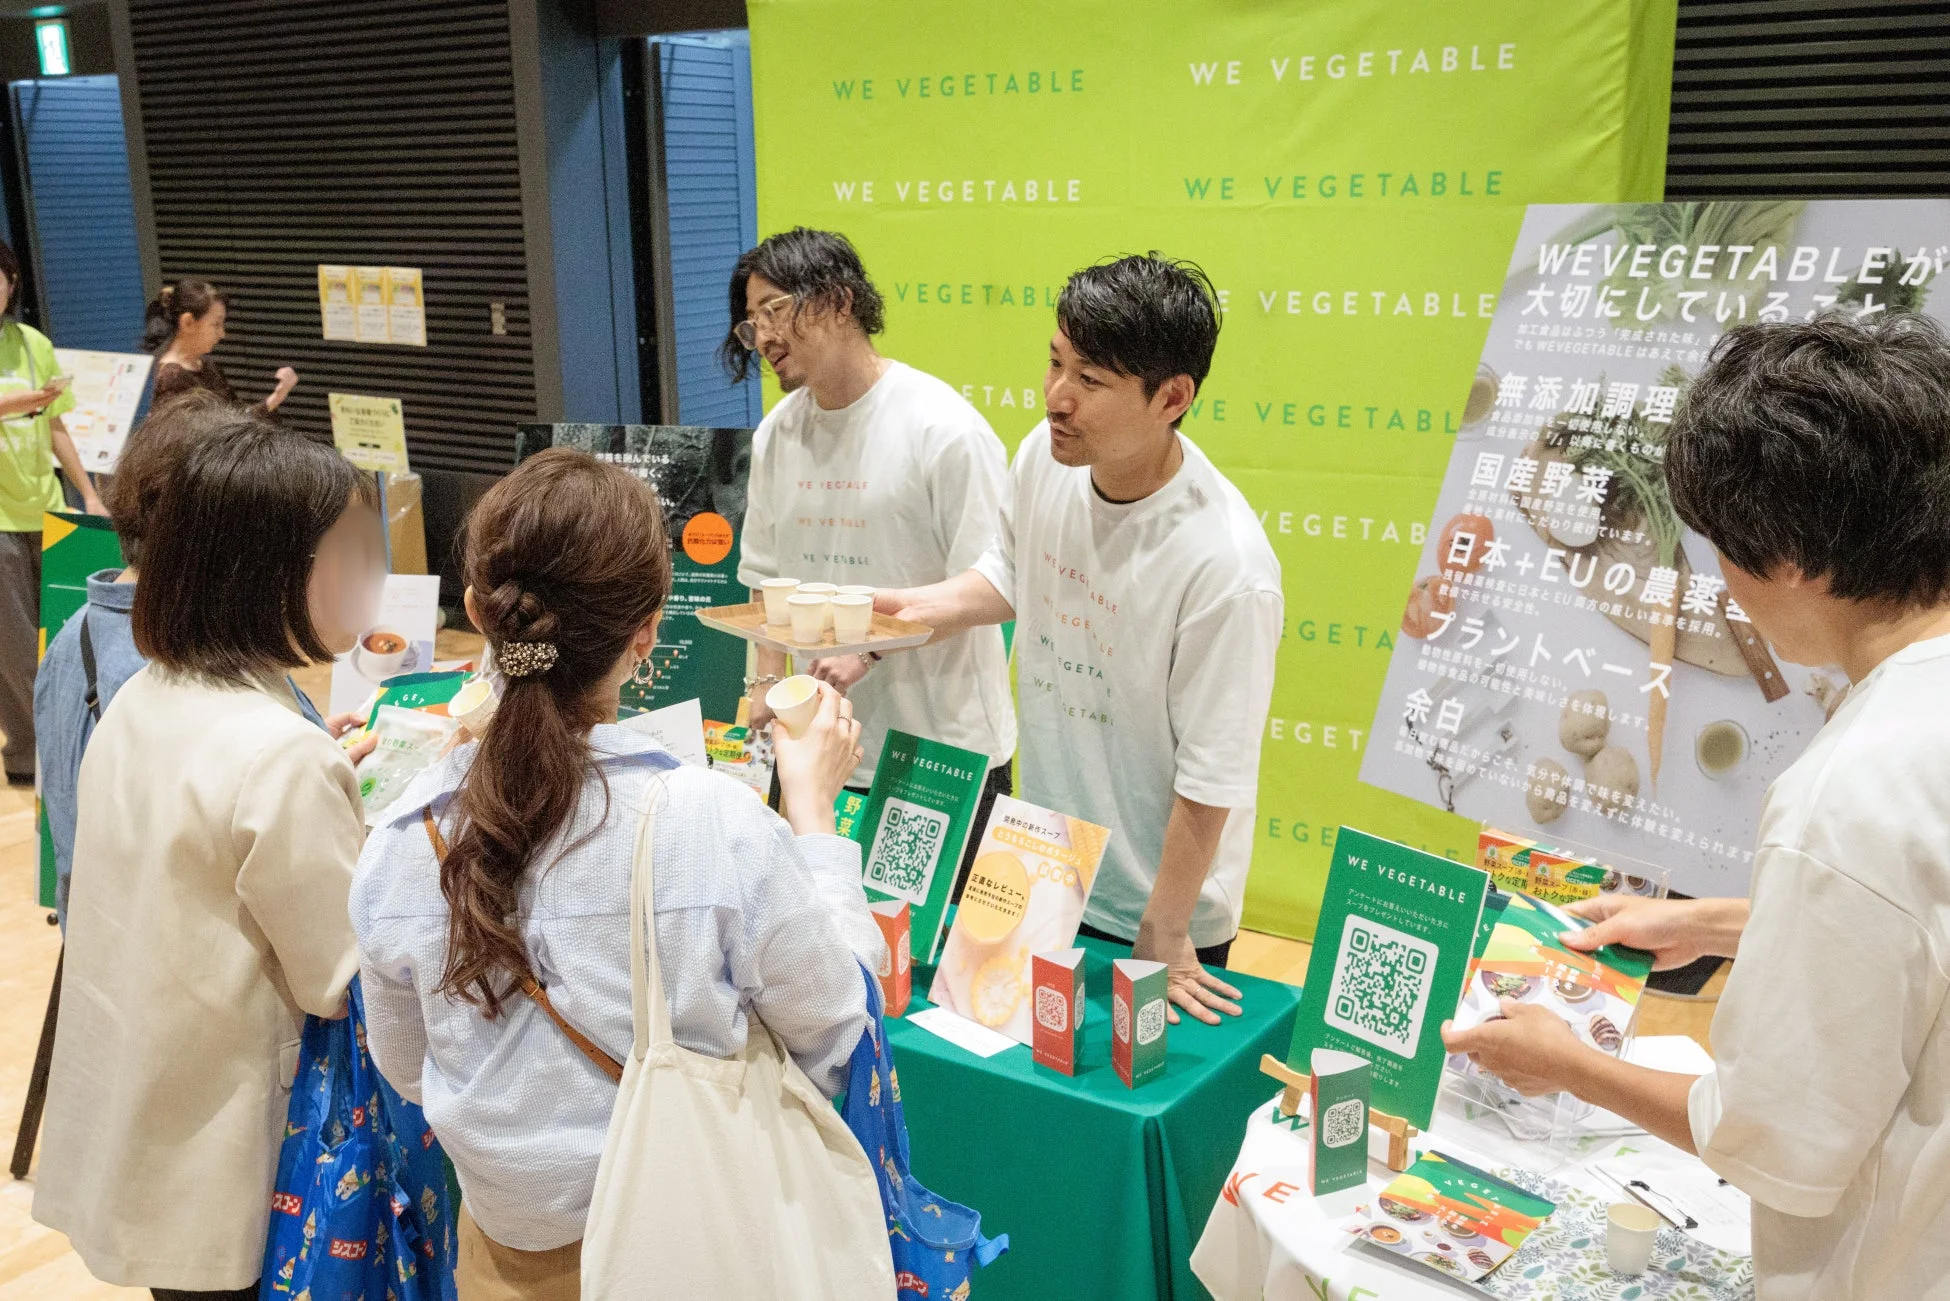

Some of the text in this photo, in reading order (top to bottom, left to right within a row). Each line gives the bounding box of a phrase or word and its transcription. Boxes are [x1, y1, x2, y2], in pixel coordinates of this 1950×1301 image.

[1188, 43, 1515, 86] WE VEGETABLE
[833, 69, 1084, 100] WE VEGETABLE
[833, 179, 1081, 203] WE VEGETABLE
[1184, 170, 1503, 200] WE VEGETABLE
[896, 282, 1056, 307] VEGETABL
[1257, 290, 1496, 319] VEGETABLE
[1494, 371, 1680, 425] 無添加調理
[1255, 401, 1459, 434] VEGETABL
[1470, 451, 1614, 504] 国産野菜
[1426, 610, 1673, 699] プラントベース
[1402, 687, 1465, 735] 余白
[892, 750, 974, 781] WE VEGETABLE
[1348, 854, 1466, 904] WE VEGETABLE
